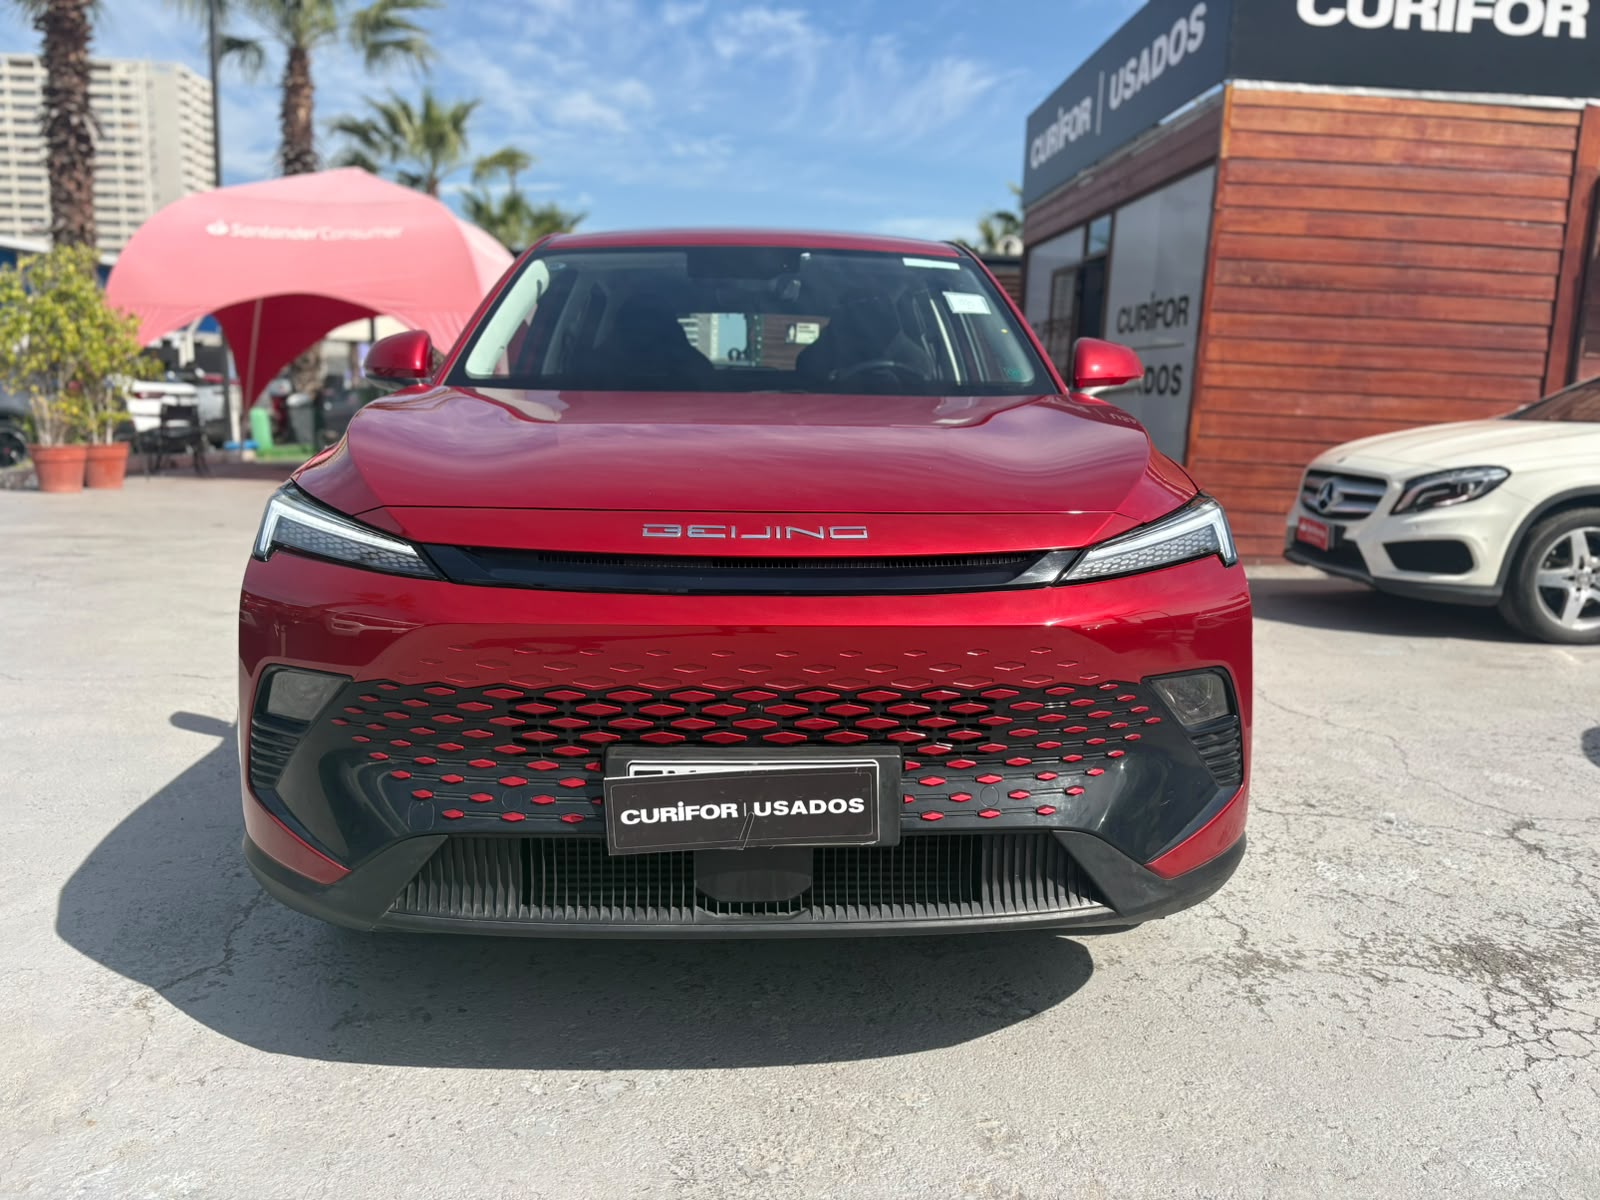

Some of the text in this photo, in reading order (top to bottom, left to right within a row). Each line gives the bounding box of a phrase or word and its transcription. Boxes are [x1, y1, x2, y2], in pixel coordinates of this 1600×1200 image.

[1109, 2, 1207, 110] USADOS
[230, 223, 318, 240] Santander
[642, 523, 869, 540] BEIJING
[753, 798, 865, 816] USADOS
